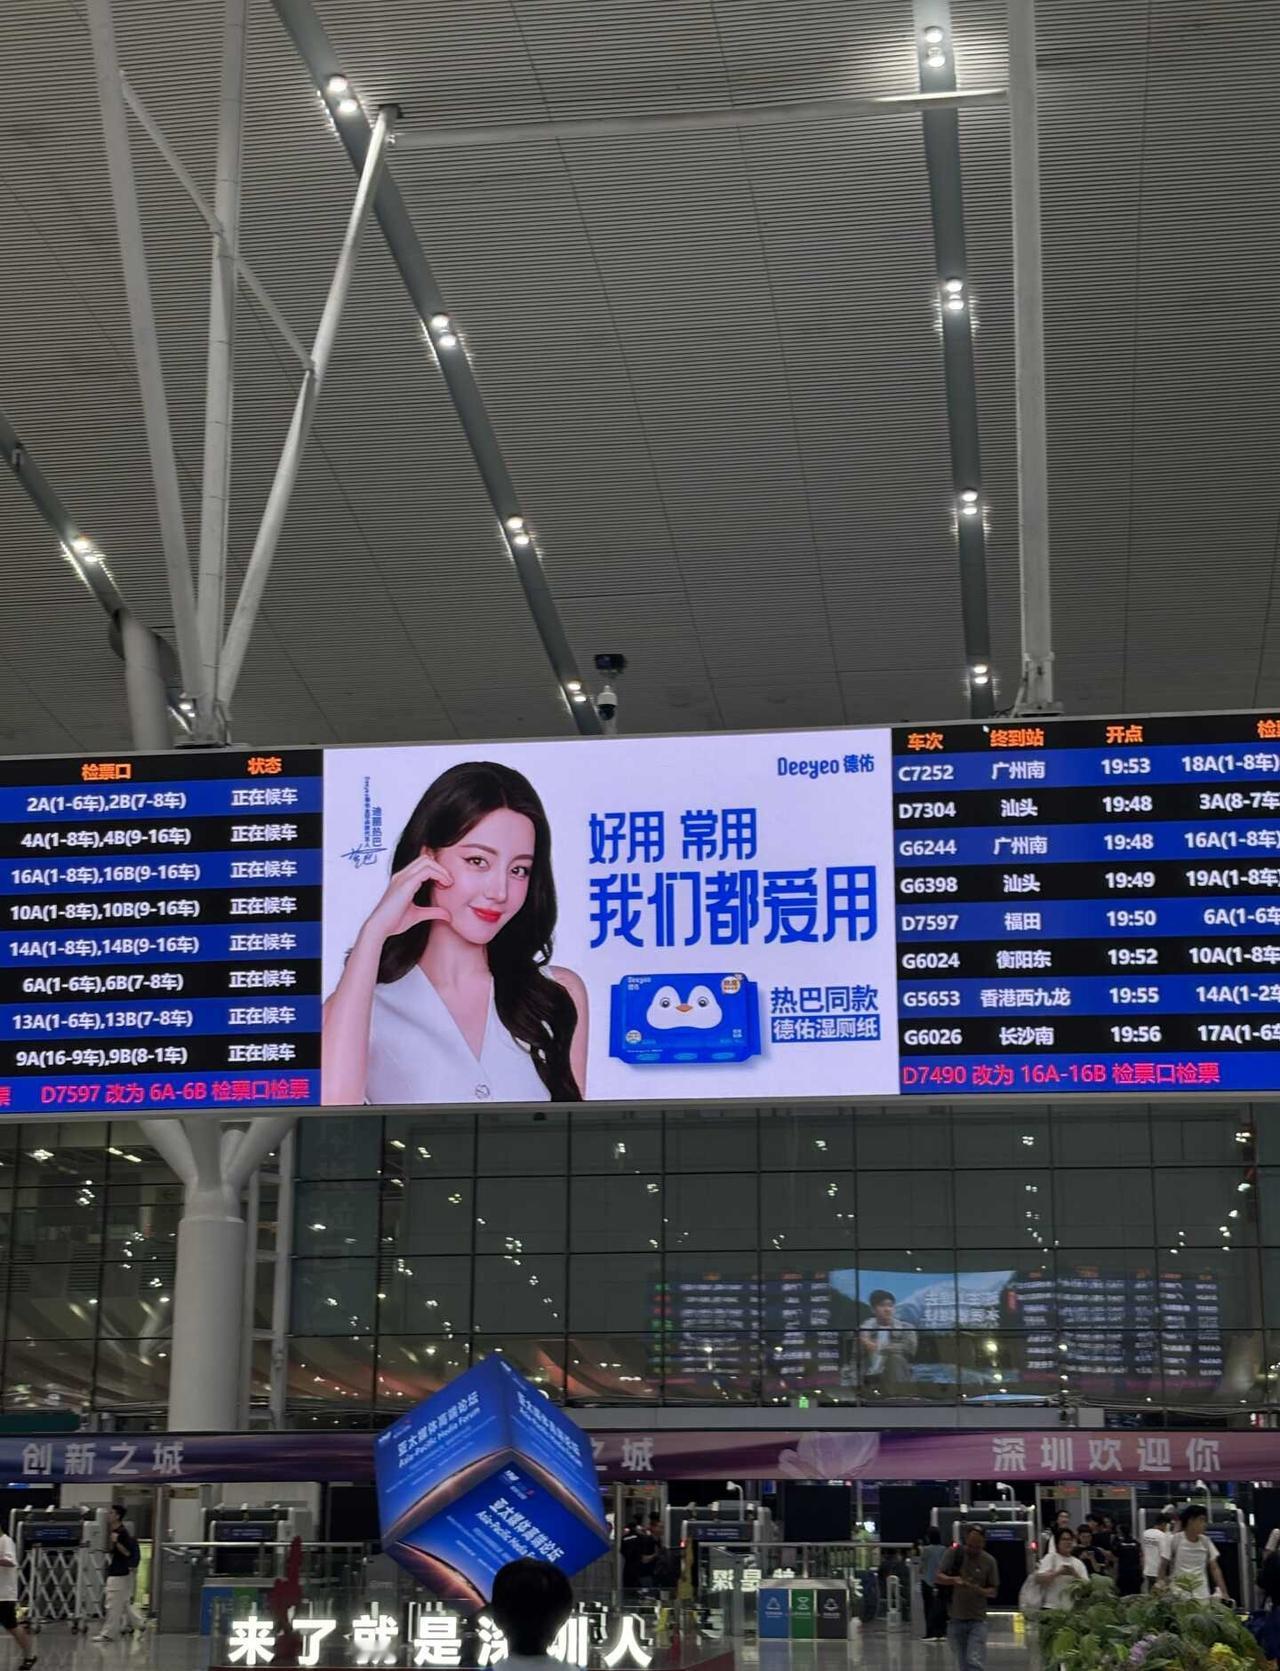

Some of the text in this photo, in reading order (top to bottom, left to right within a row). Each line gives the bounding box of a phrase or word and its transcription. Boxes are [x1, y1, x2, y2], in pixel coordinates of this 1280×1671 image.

[908, 719, 1280, 750] 车次 终到站 开点 检
[82, 757, 281, 780] 检票口 状态
[777, 754, 875, 779] Deeyeo 德佑
[899, 765, 953, 781] C7252
[992, 761, 1045, 779] 广州南
[1102, 758, 1150, 774] 19:53
[232, 788, 297, 806] 正在候车
[899, 791, 1280, 818] D7304 汕头 19:48 3A(8-7车
[231, 824, 297, 842] 正在候车
[589, 808, 757, 864] 好用 常用
[900, 840, 957, 855] G6244
[994, 836, 1047, 854] 广州南
[1105, 834, 1153, 849] 19:48
[231, 860, 297, 878] 正在候车
[901, 868, 1280, 893] G6398 汕头 19:49 19A(1-8车
[230, 896, 297, 914] 正在候车
[589, 866, 877, 948] 我们都爱用
[902, 915, 958, 930] D7597
[1005, 913, 1040, 930] 福田
[1107, 910, 1156, 926] 19:50
[230, 933, 296, 951] 正在候车
[902, 953, 960, 969] G6024
[997, 950, 1051, 969] 衡阳东
[1108, 949, 1157, 964] 19:52
[229, 970, 296, 987] 正在候车
[771, 985, 878, 1013] 热巴同款
[904, 991, 960, 1006] G5653
[981, 988, 1070, 1007] 香港西九龙
[1110, 988, 1158, 1003] 19:55
[229, 1007, 296, 1024] 正在候车
[773, 1017, 877, 1039] 德佑湿厕纸
[904, 1029, 962, 1045] G6026
[999, 1027, 1054, 1045] 长沙南
[1111, 1026, 1161, 1042] 19:56
[228, 1043, 295, 1061] 正在候车
[903, 1062, 1220, 1085] D7490 改为 16A-16B 检票口检票
[41, 1080, 309, 1104] D7597 改为 6A-6B 检票口检票
[22, 1442, 185, 1476] 创新之城
[992, 1437, 1222, 1473] 深圳欢迎你
